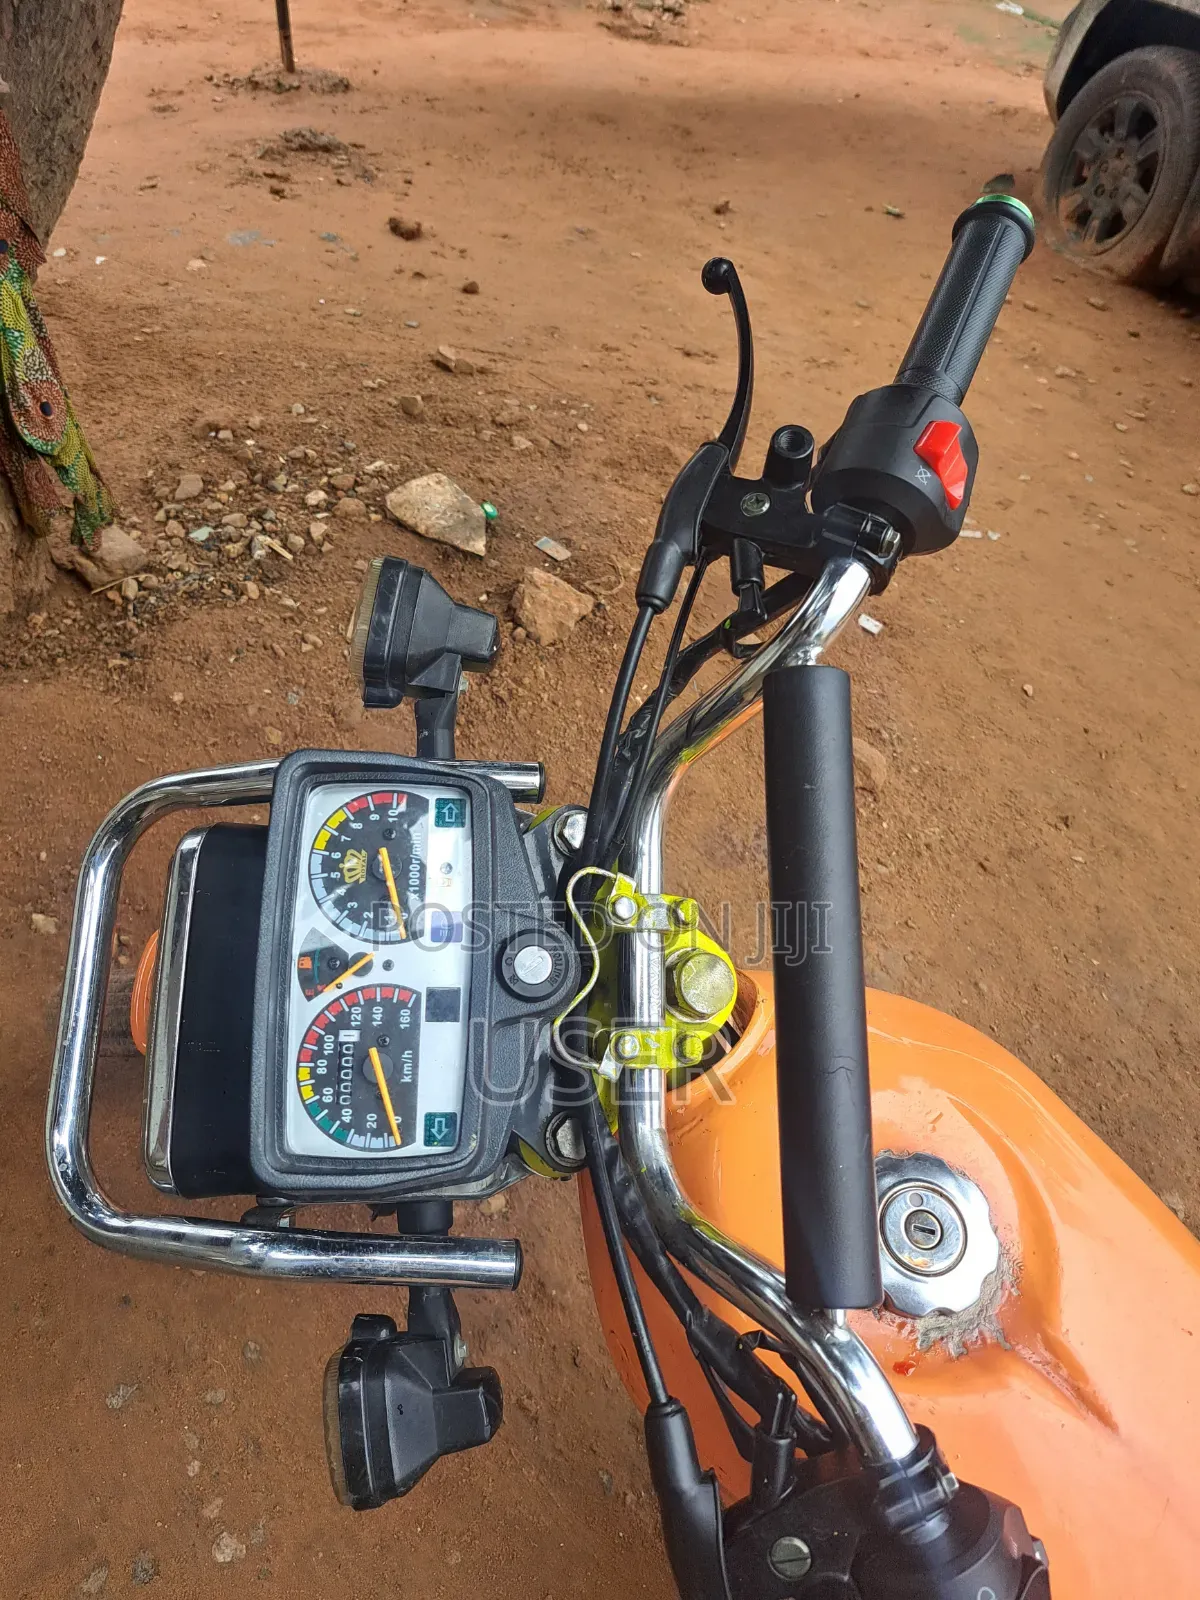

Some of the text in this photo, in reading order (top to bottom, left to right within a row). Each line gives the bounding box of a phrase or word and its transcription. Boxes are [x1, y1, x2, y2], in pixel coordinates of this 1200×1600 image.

[388, 809, 399, 823] 10
[351, 822, 363, 830] 8
[330, 851, 342, 859] 6
[330, 871, 341, 879] 5
[336, 888, 347, 896] 4
[347, 901, 358, 909] 3
[363, 911, 374, 919] 2
[350, 1006, 362, 1027] 120
[372, 1006, 383, 1026] 140
[400, 1008, 411, 1029] 160
[323, 1034, 335, 1055] 100
[316, 1059, 328, 1075] 80
[401, 1050, 413, 1083] km/h
[322, 1087, 334, 1103] 60
[341, 1108, 353, 1123] 40
[366, 1113, 377, 1129] 20
